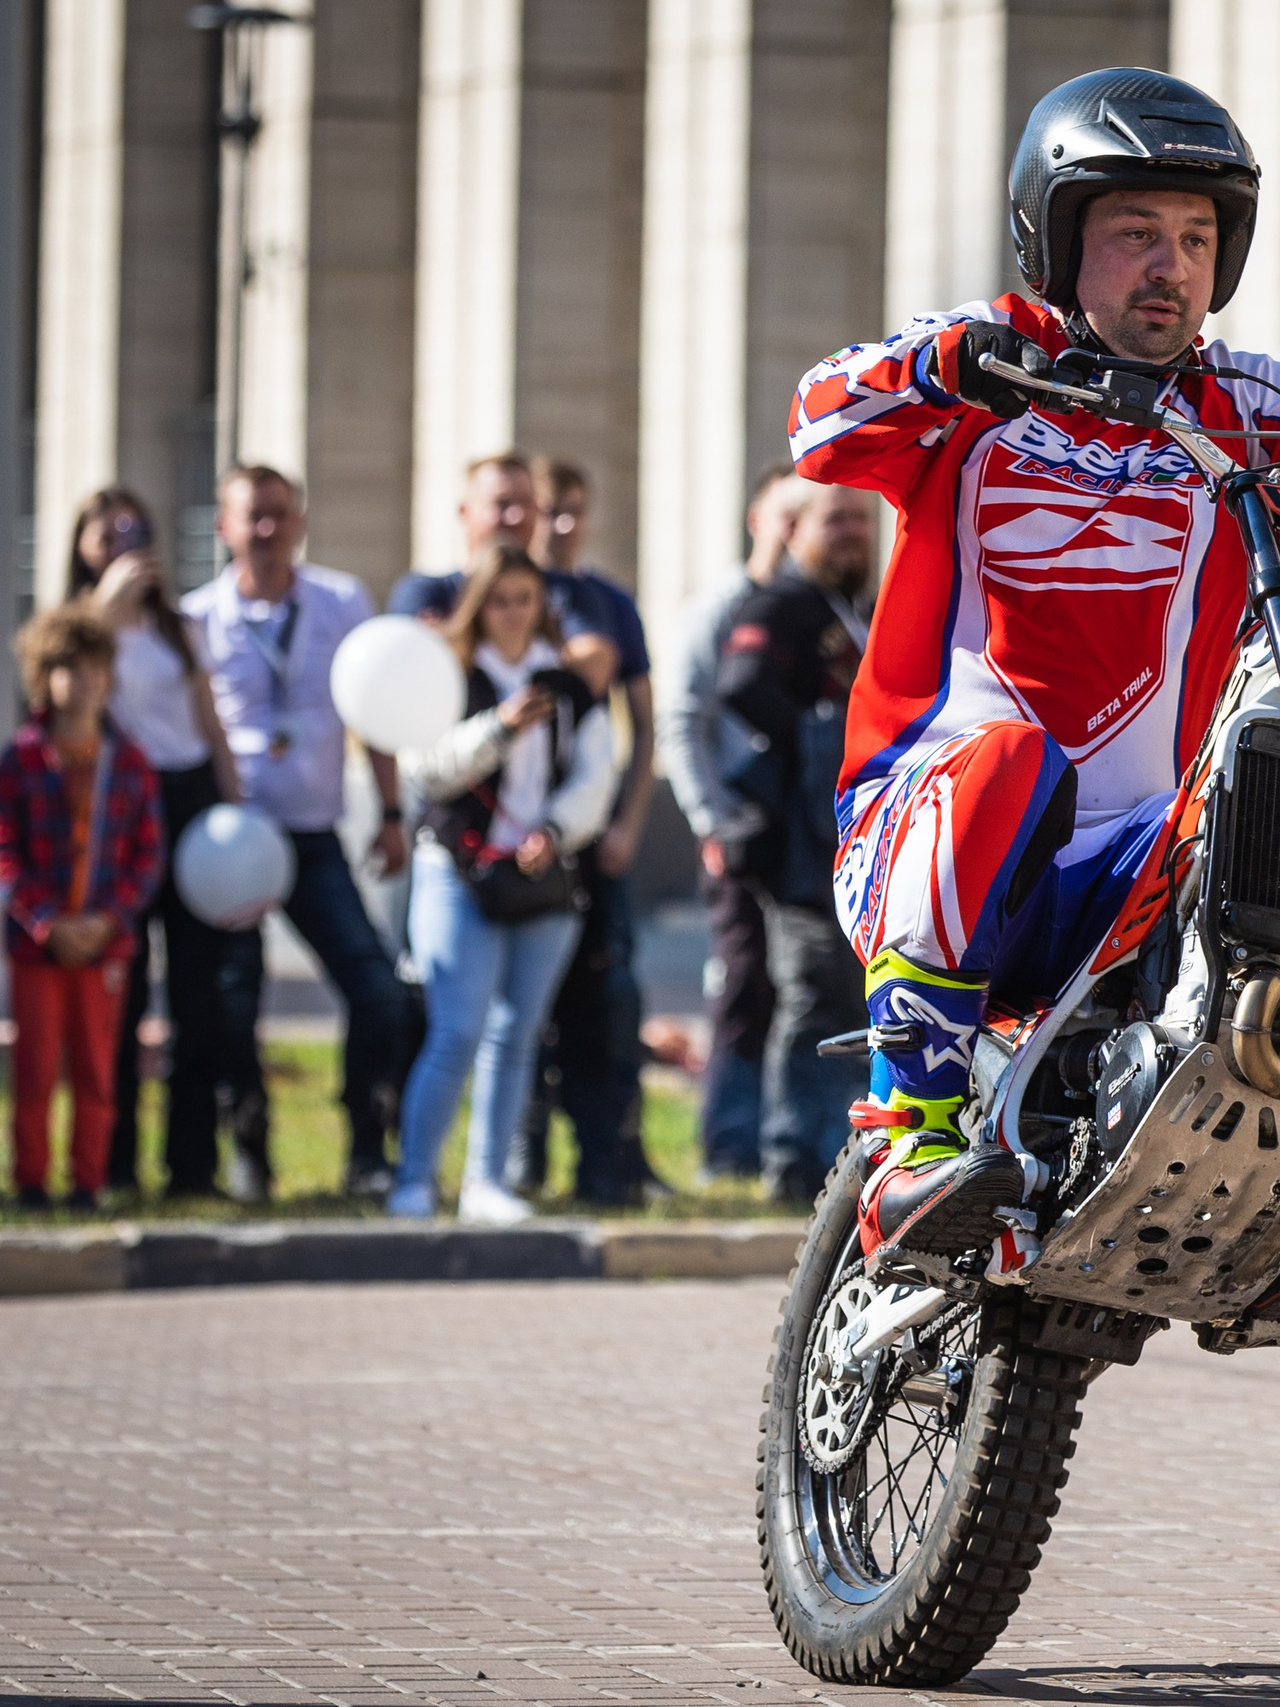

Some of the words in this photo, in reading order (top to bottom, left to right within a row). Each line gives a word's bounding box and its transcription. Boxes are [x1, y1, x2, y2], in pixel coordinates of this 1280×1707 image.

[999, 410, 1193, 478] Beta
[1086, 697, 1121, 733] BETA
[1122, 666, 1153, 702] TRIAL
